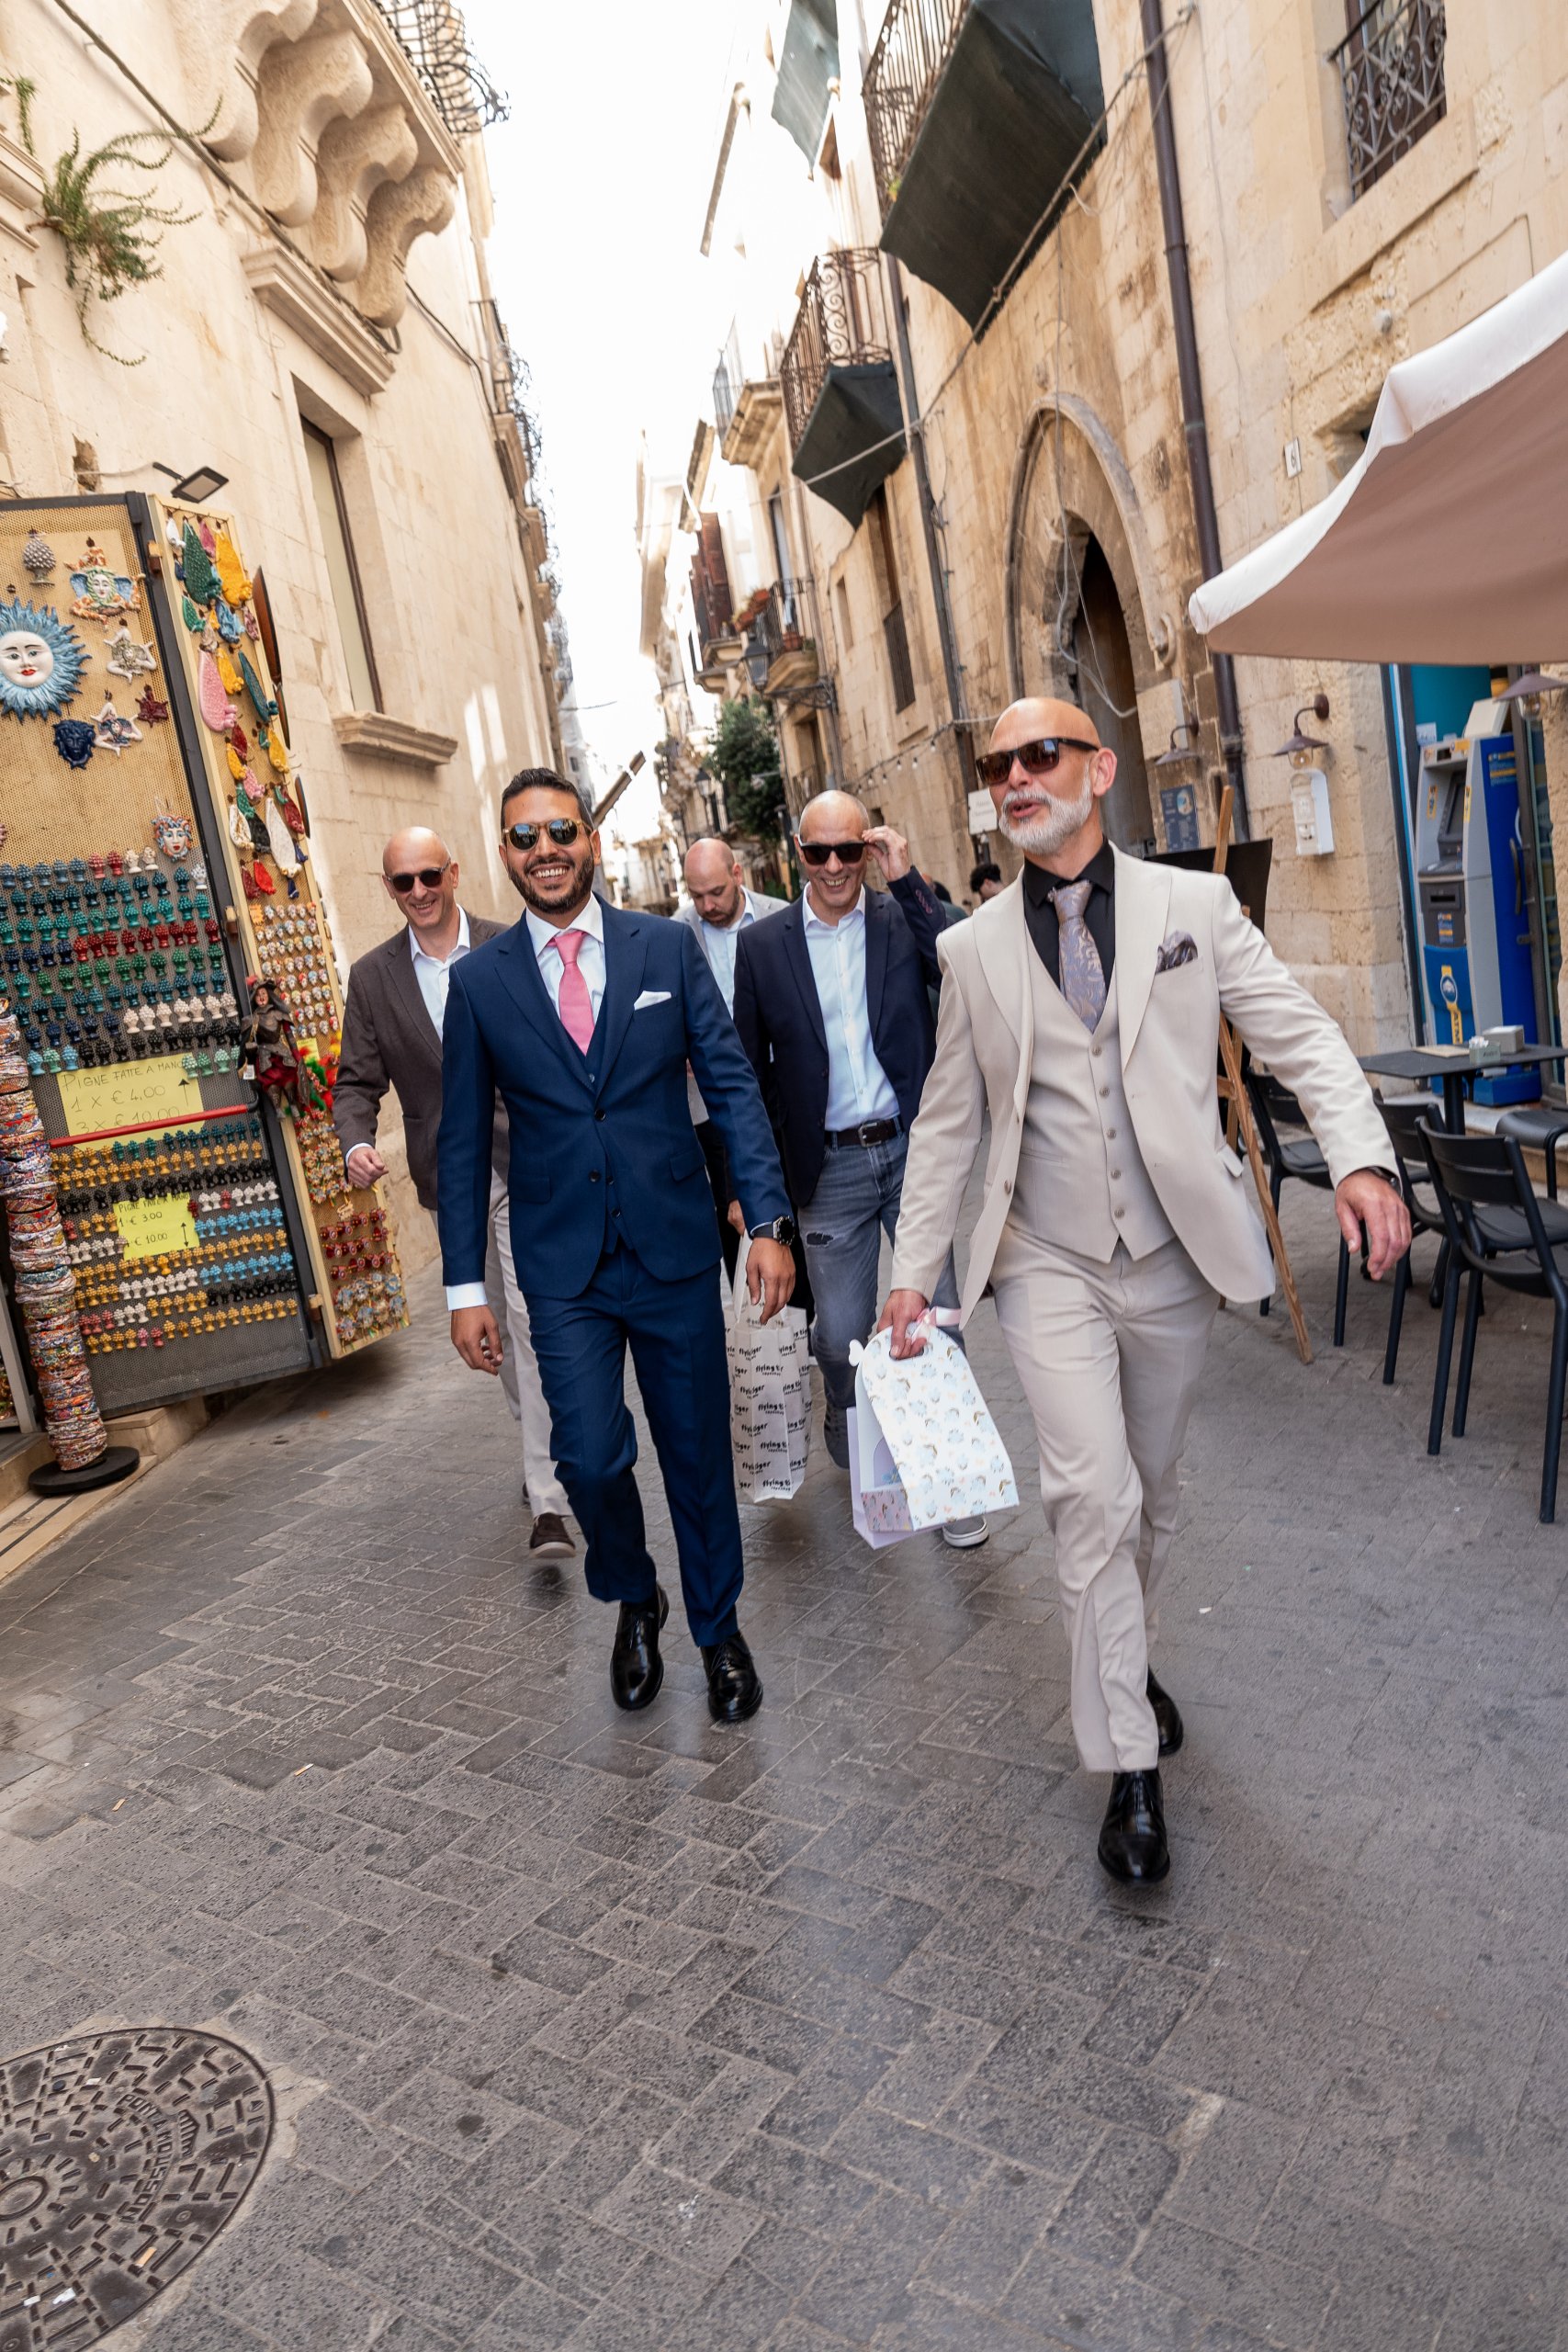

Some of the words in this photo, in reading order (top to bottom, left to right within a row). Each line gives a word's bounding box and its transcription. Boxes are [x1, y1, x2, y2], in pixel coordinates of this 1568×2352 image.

[62, 1073, 109, 1091] PIGNE
[112, 1068, 144, 1081] FATTE
[146, 1066, 155, 1074] A
